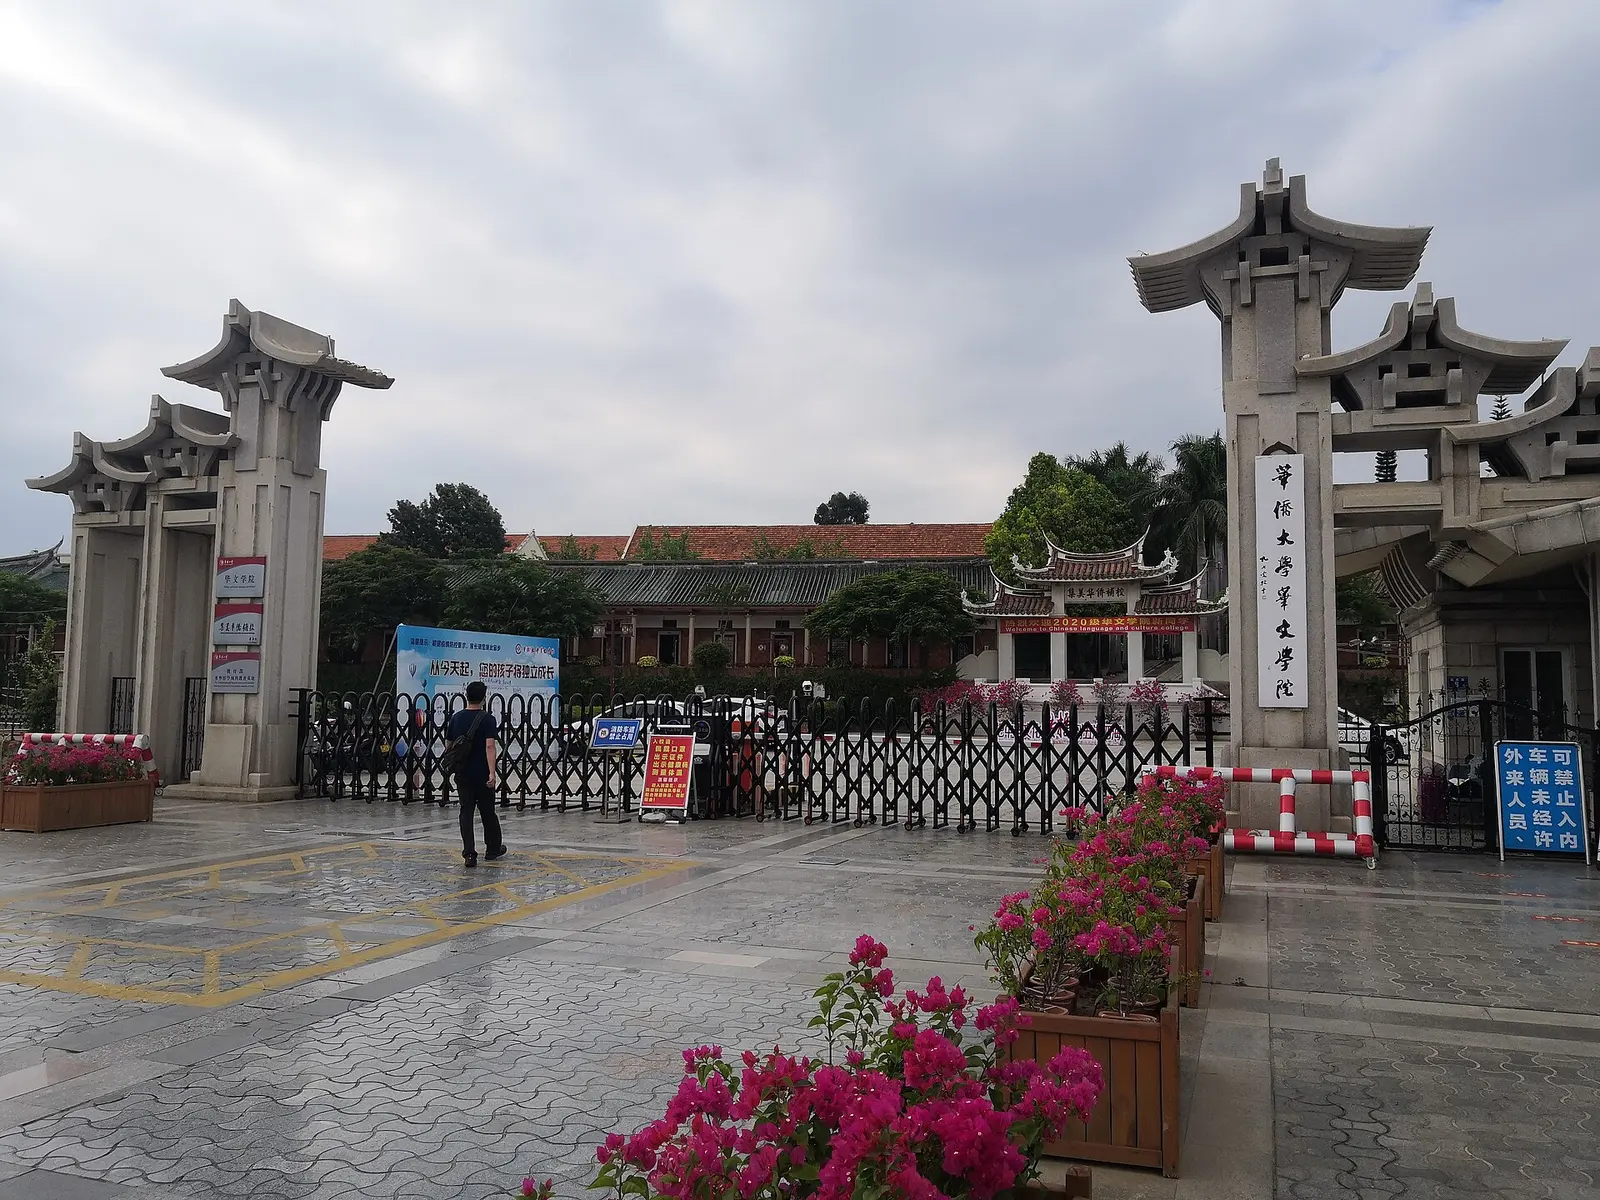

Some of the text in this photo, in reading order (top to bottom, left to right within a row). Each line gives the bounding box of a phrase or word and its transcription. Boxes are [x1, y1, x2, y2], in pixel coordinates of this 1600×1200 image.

[1503, 748, 1528, 843] 外来人员、
[1528, 747, 1554, 848] 车辆未经许
[1552, 749, 1578, 849] 可禁止入内
